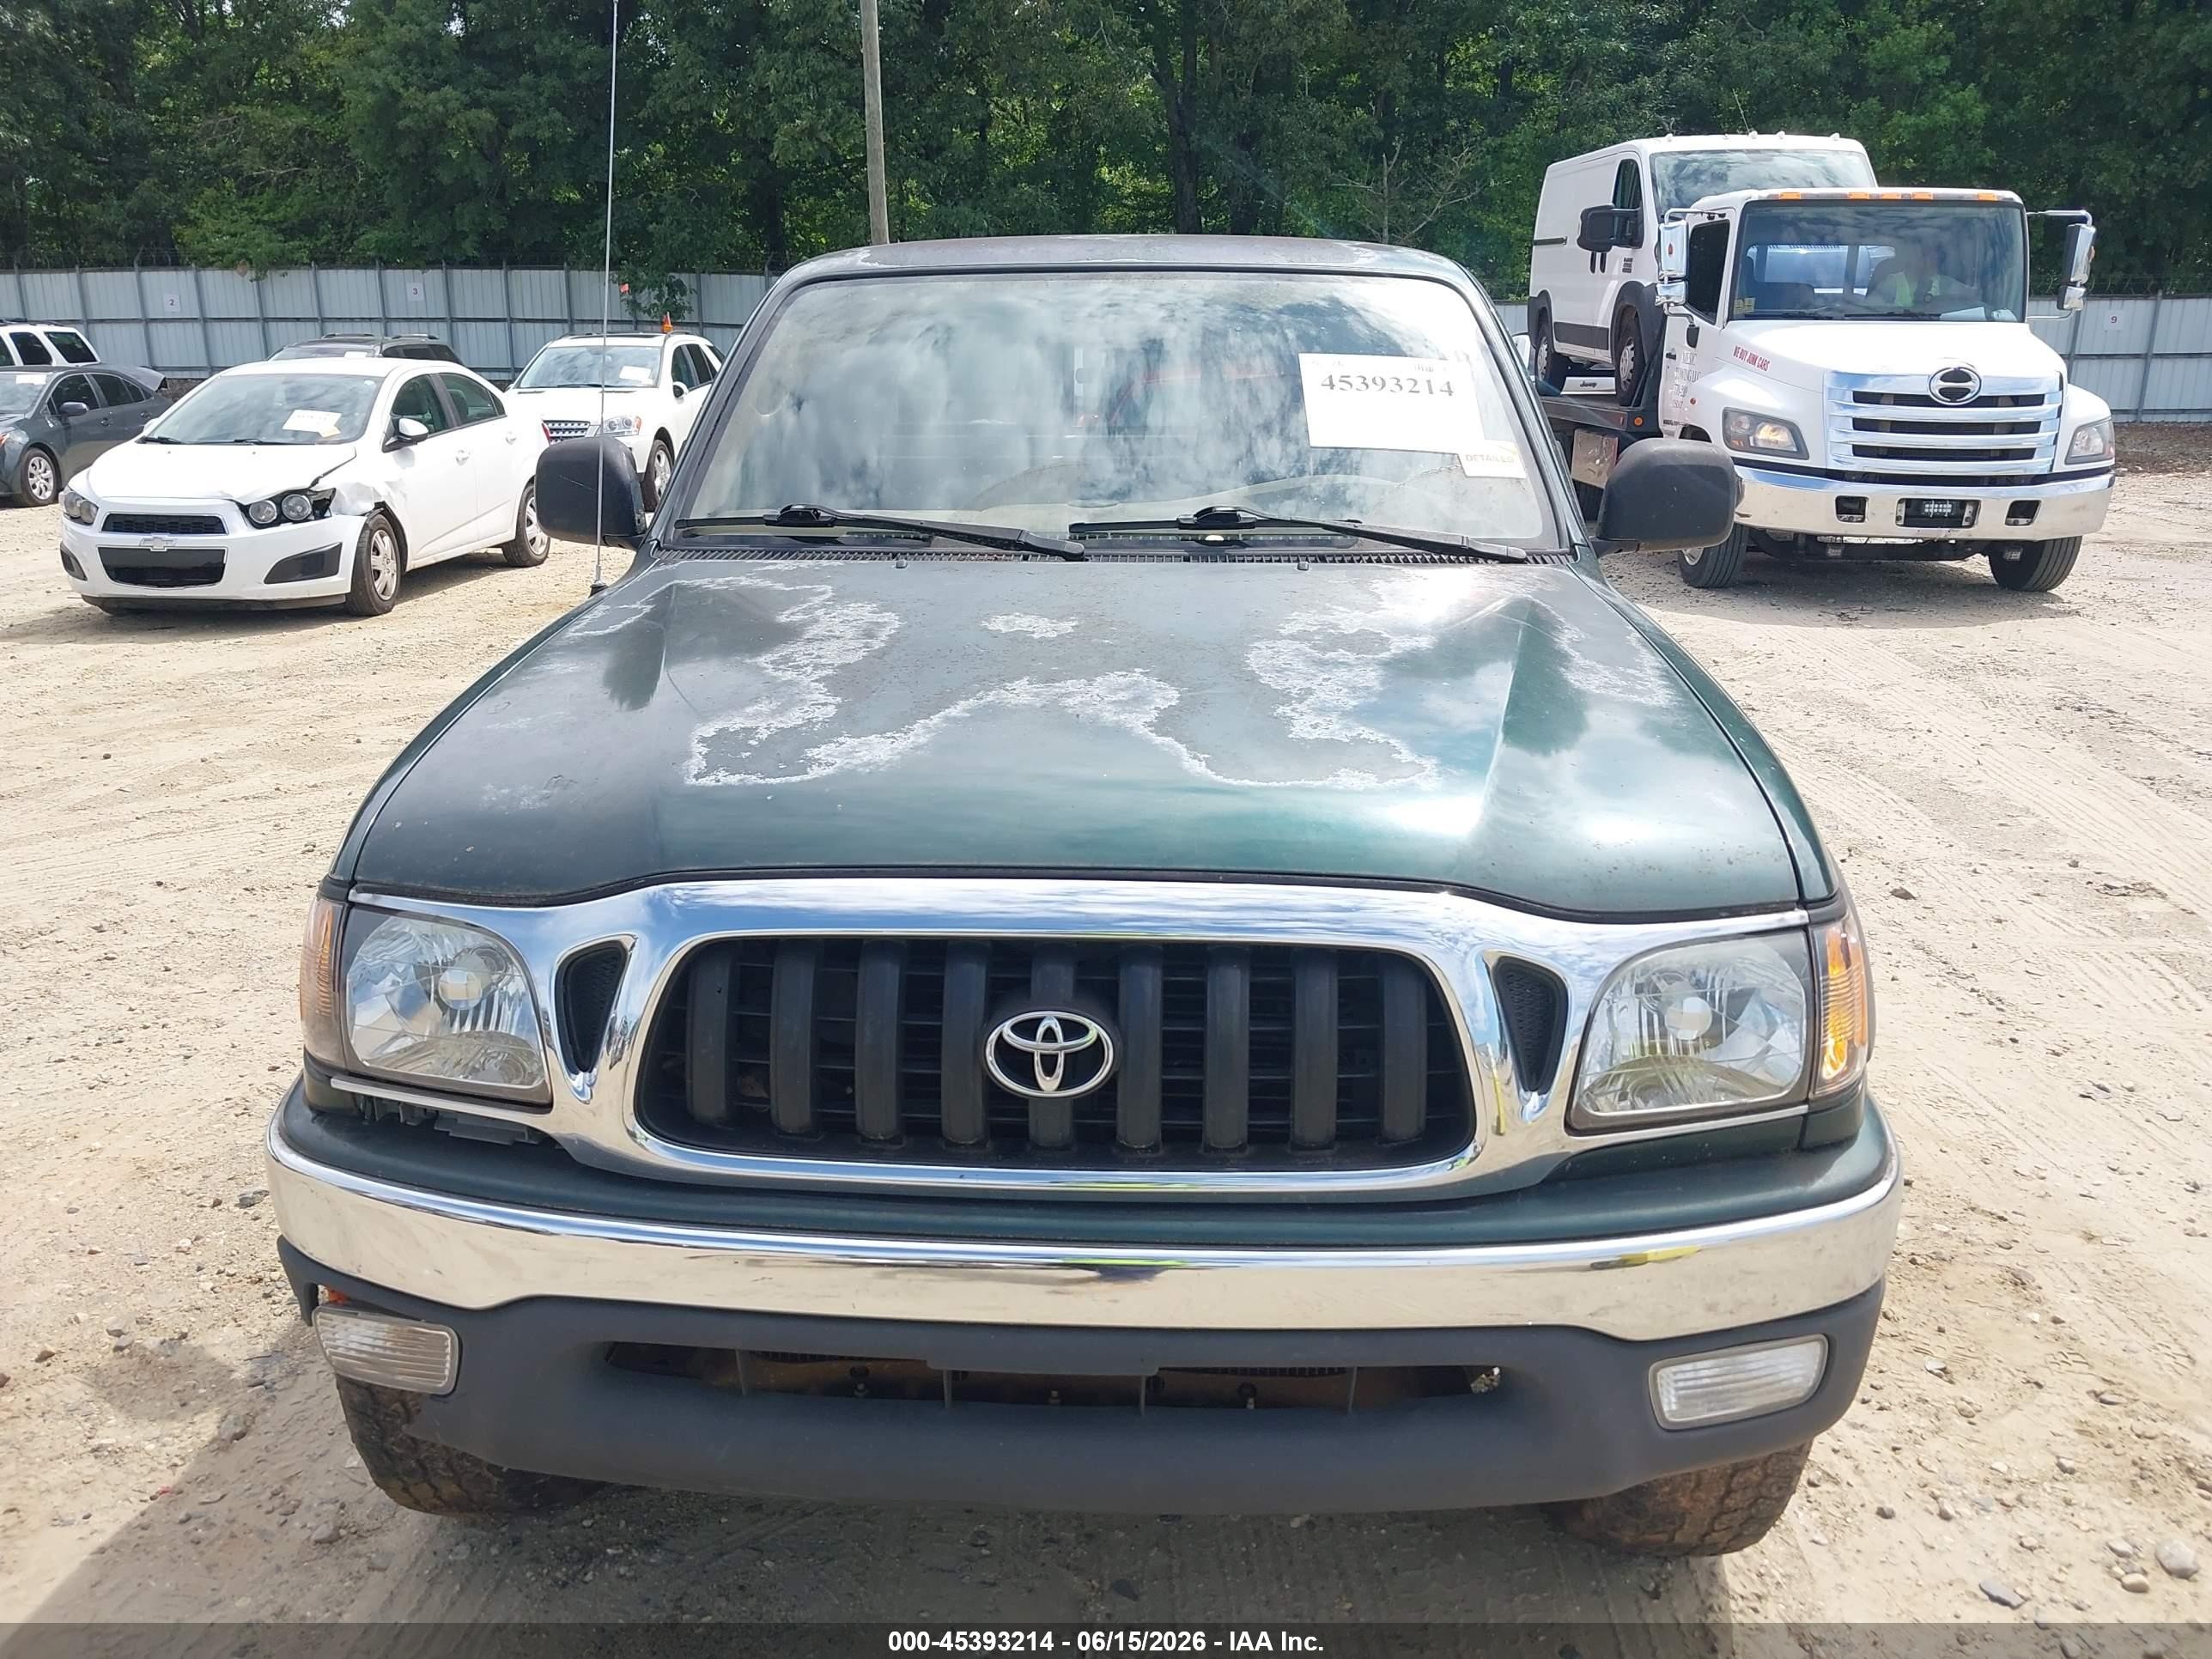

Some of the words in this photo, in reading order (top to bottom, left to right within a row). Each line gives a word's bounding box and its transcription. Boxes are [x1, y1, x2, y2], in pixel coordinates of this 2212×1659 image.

[168, 298, 174, 307] 2
[2111, 315, 2118, 324] 9
[1747, 352, 1759, 367] JUNK
[1757, 357, 1771, 372] CARS
[1321, 374, 1454, 397] 45393214
